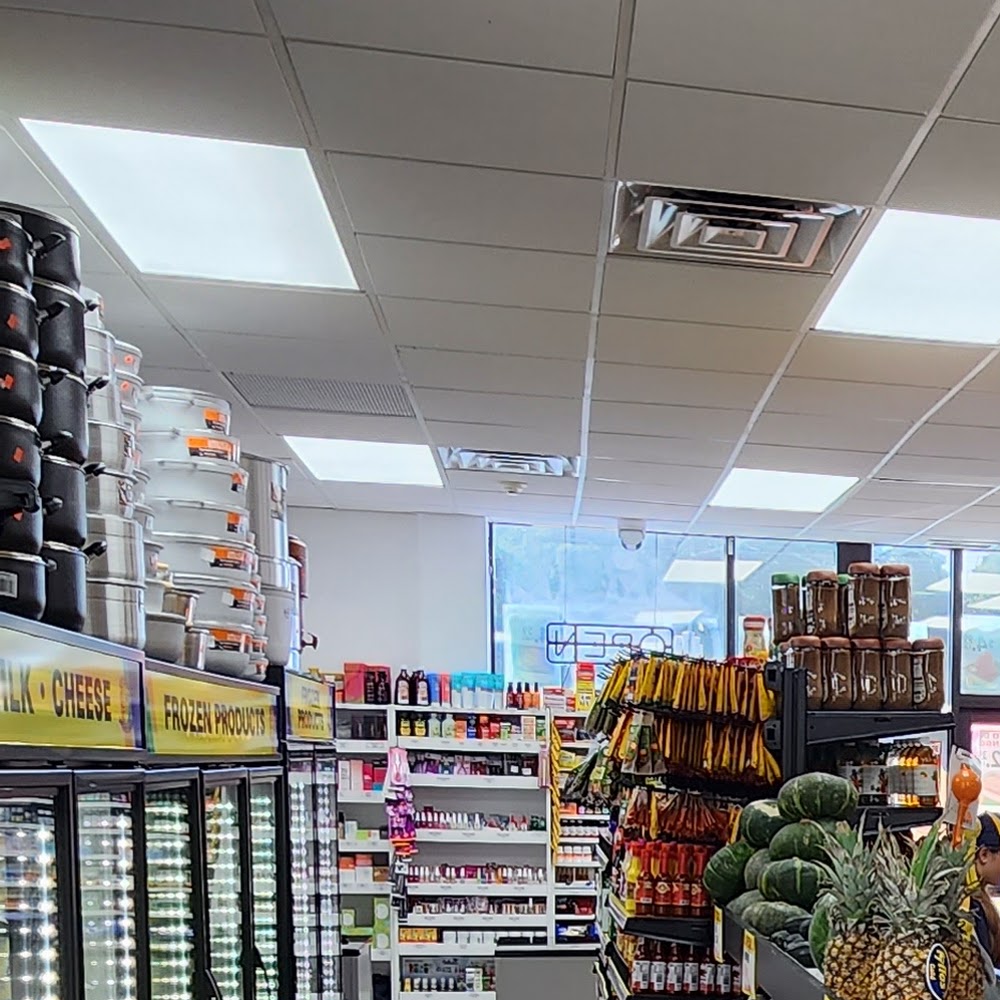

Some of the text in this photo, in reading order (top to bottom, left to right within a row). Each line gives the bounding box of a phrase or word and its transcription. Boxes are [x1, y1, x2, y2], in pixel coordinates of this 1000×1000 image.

[52, 668, 112, 722] CHEESE
[163, 694, 265, 737] FROZEN PRODUCTS
